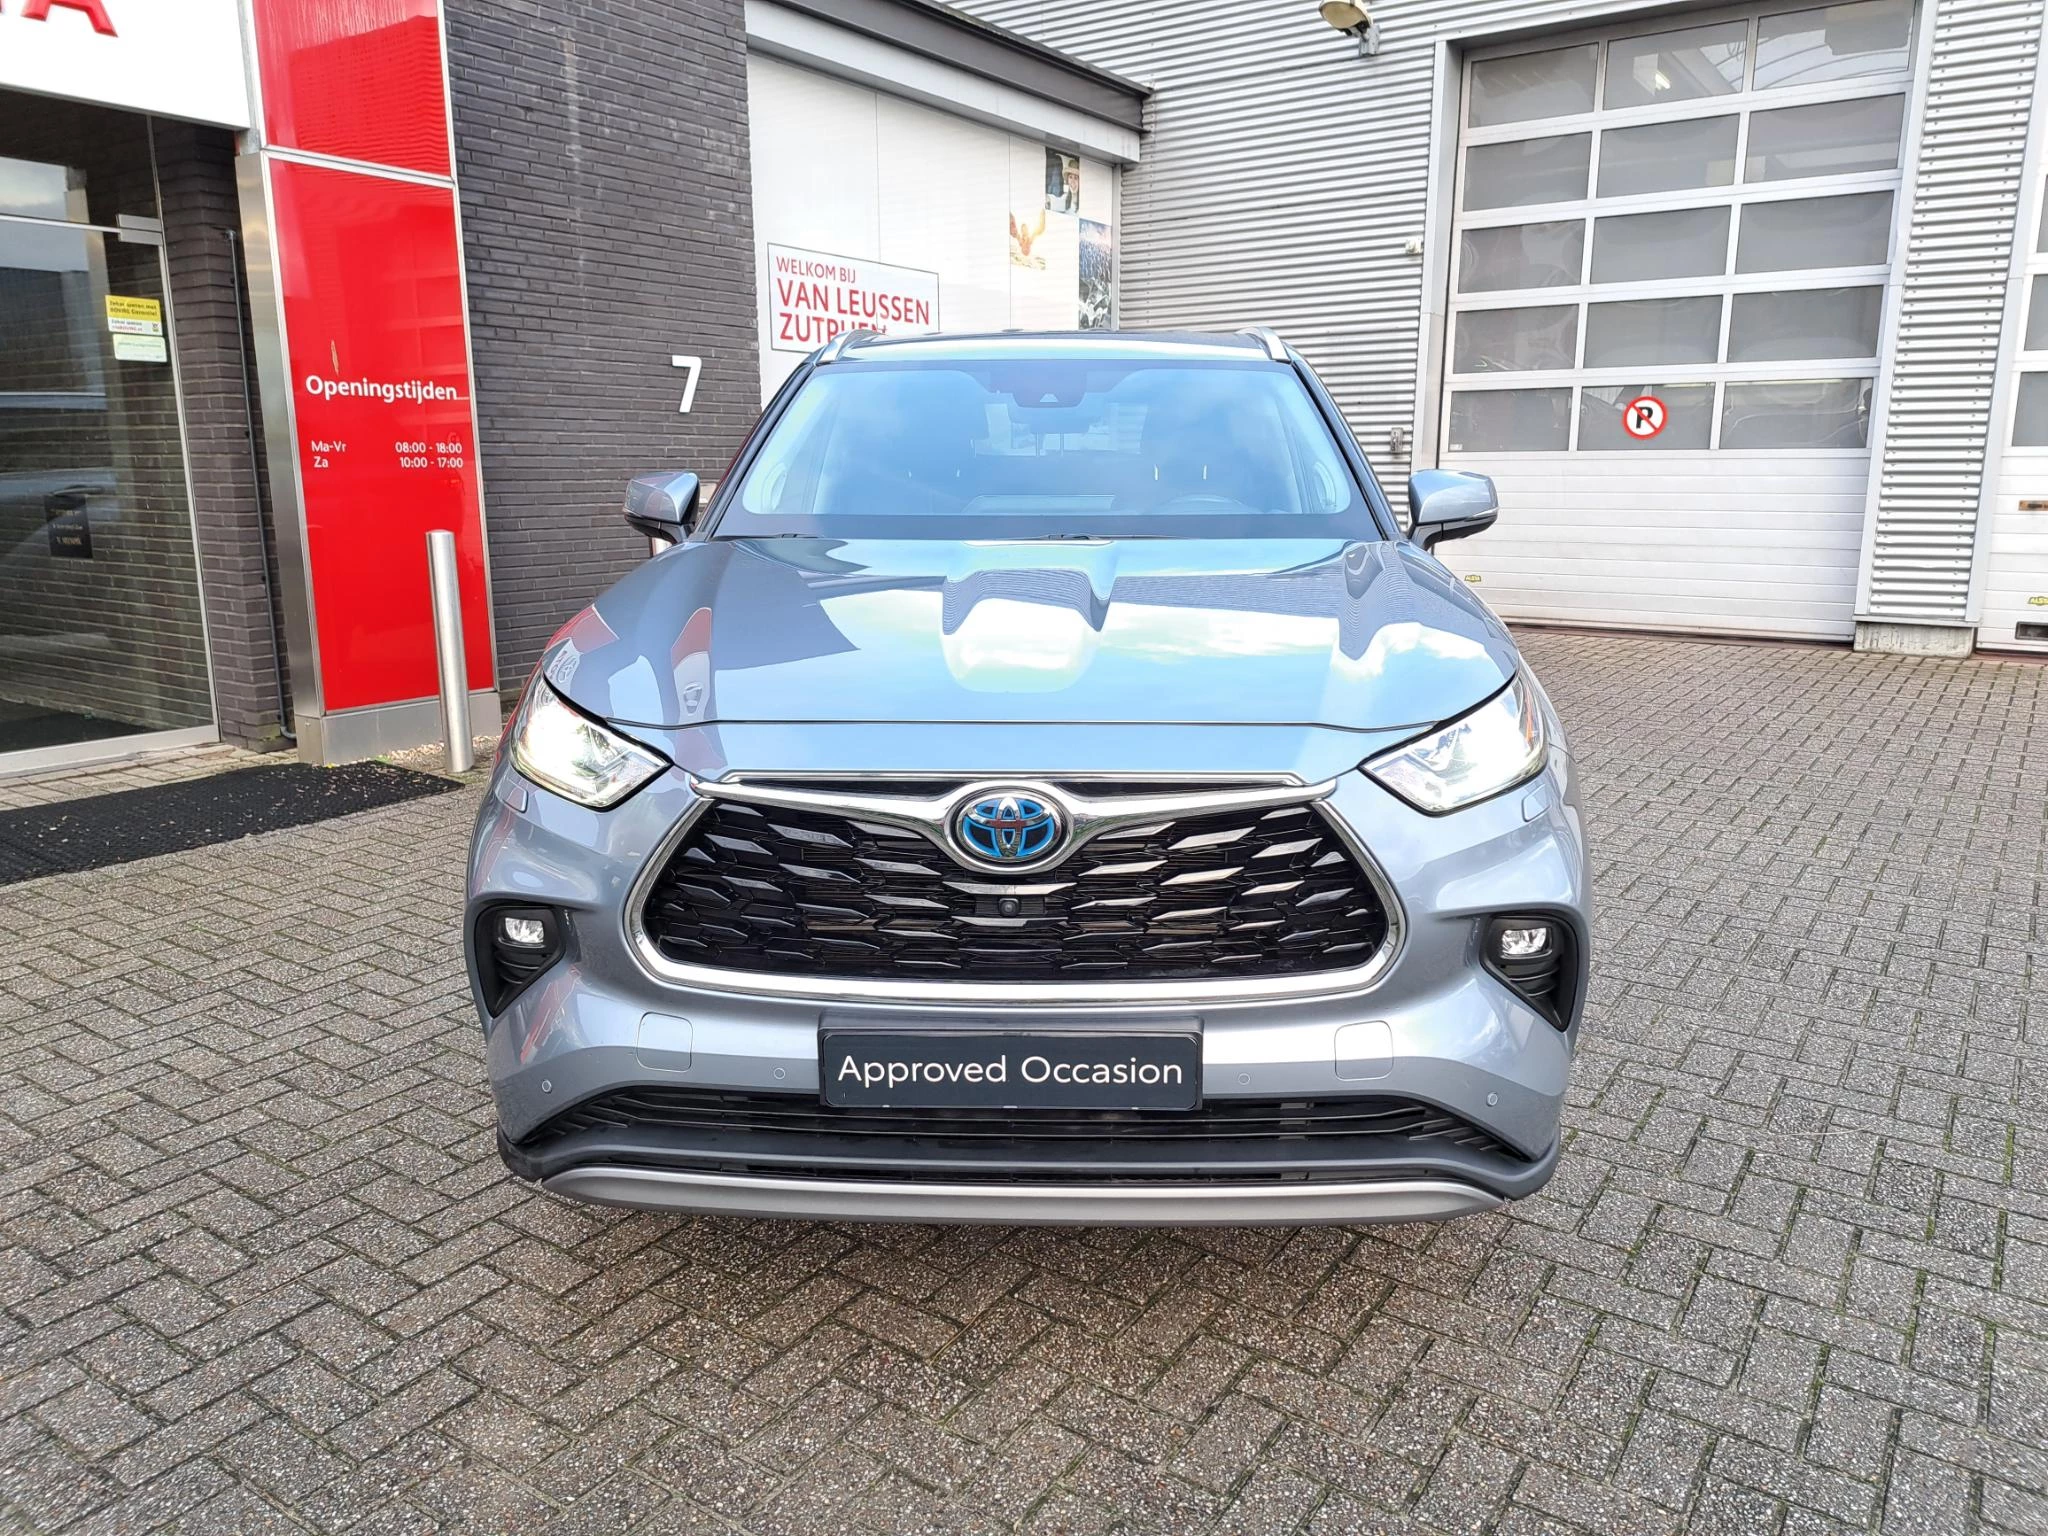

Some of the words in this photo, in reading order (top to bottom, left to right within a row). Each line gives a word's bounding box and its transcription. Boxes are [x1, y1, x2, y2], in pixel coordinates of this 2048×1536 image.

[776, 256, 837, 280] WELKOM
[840, 268, 857, 284] BIJ
[777, 278, 829, 312] VAN
[836, 287, 930, 326] LEUSSEN
[779, 312, 888, 343] ZUTP
[305, 375, 457, 404] Openingstijden
[671, 355, 702, 413] 7
[311, 440, 346, 453] Ma-Vr
[395, 441, 427, 454] 08:00
[436, 442, 463, 454] 18:00
[313, 456, 329, 468] Za
[400, 456, 428, 469] 10:00
[437, 457, 464, 469] 17:00
[838, 1055, 1007, 1089] Approved
[1020, 1056, 1183, 1085] Occasion
